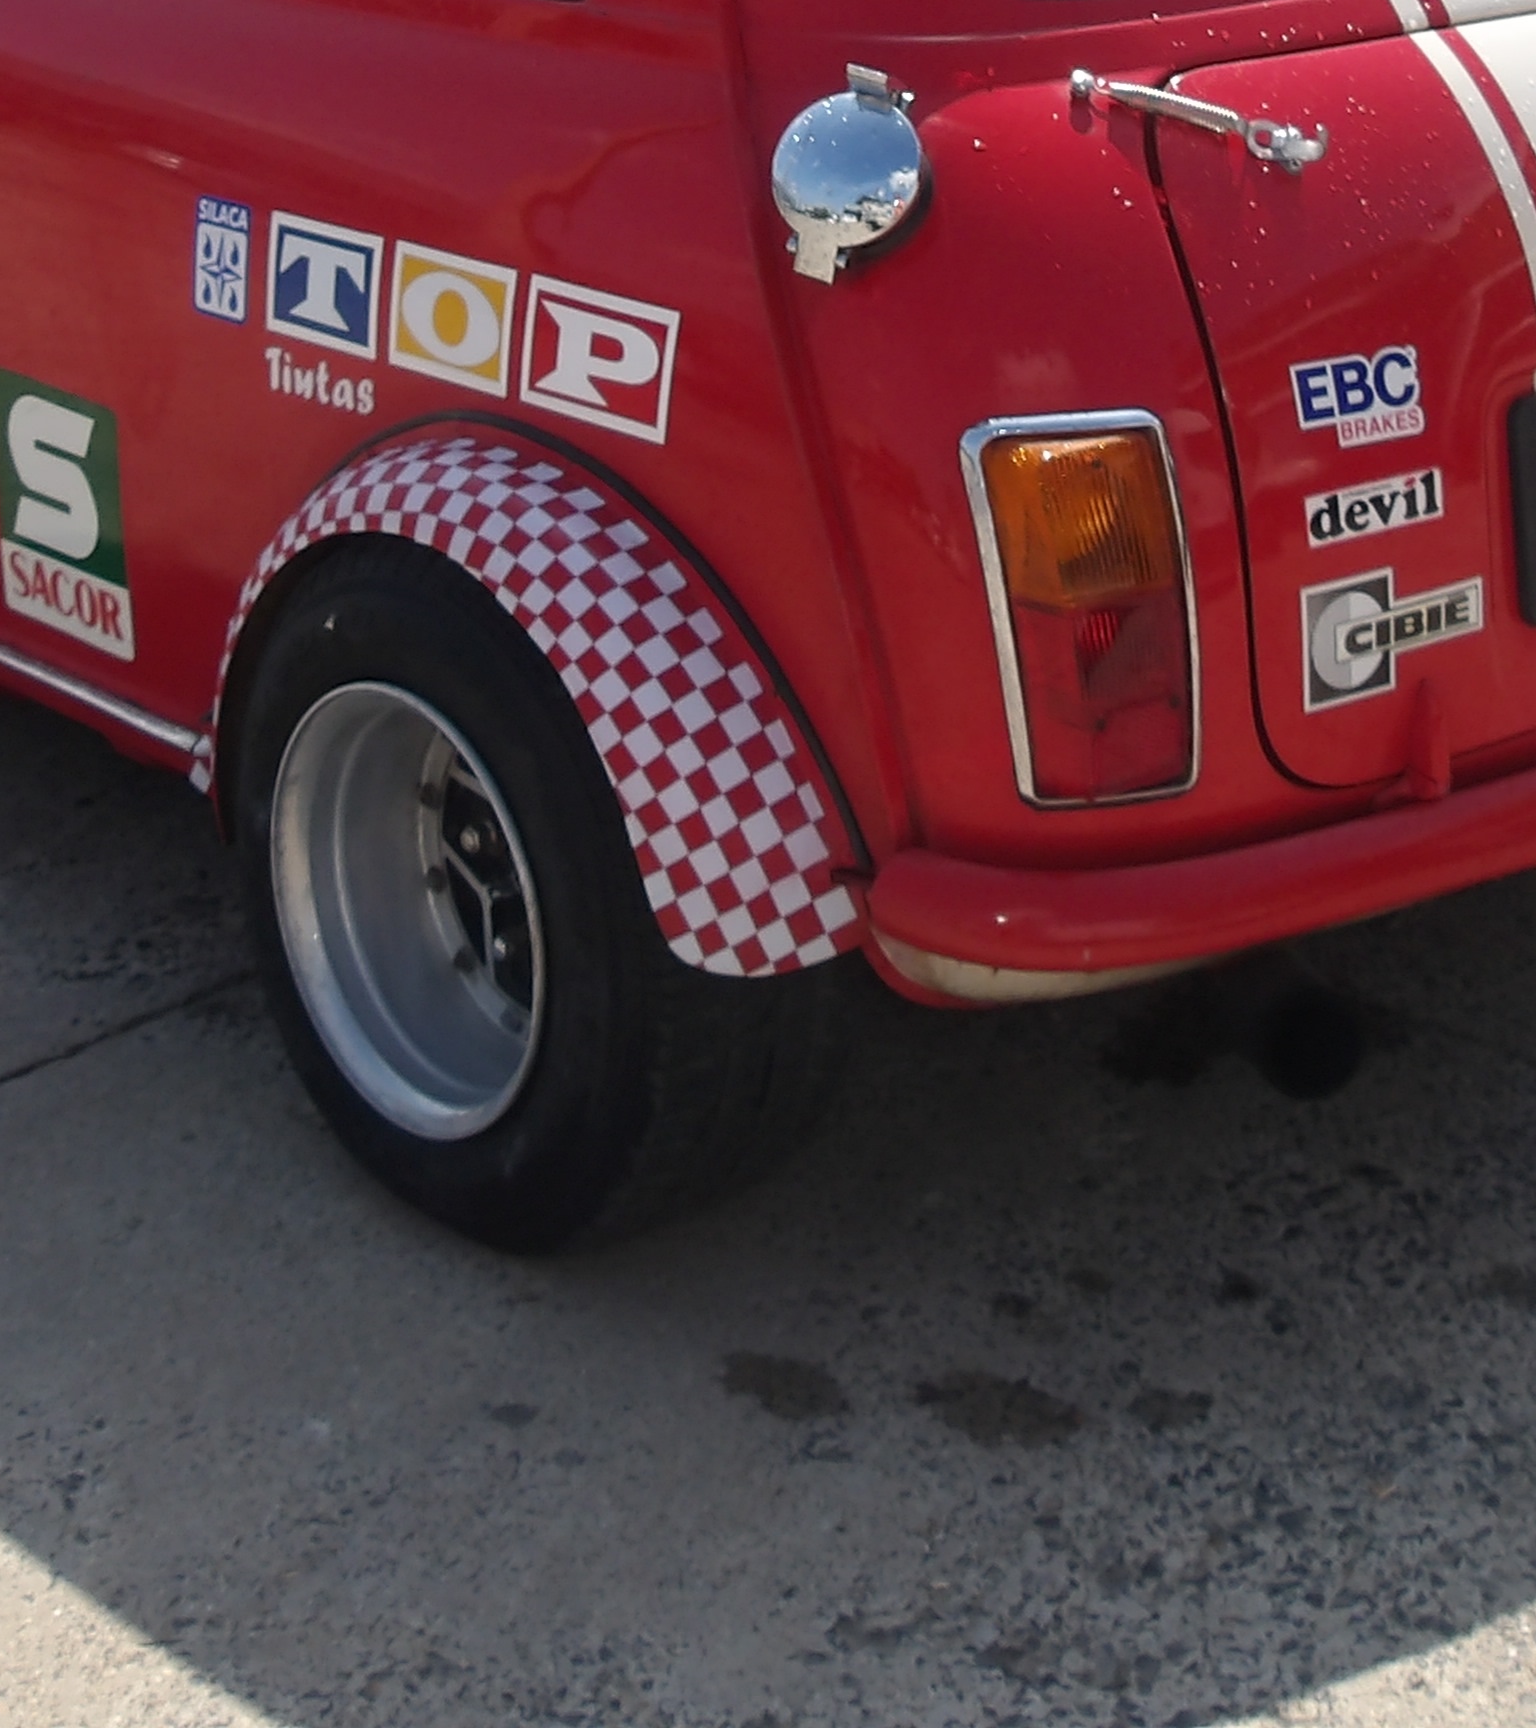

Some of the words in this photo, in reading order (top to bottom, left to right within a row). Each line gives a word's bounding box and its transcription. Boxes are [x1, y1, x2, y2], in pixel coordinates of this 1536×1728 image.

[198, 199, 249, 232] SILACA
[279, 244, 661, 407] TOP
[264, 347, 376, 415] Tintas
[1293, 352, 1416, 424] EBC
[1340, 408, 1421, 442] BRAKES
[1310, 470, 1440, 542] devil
[9, 550, 124, 642] SACOR
[1344, 593, 1470, 656] CIBIE
